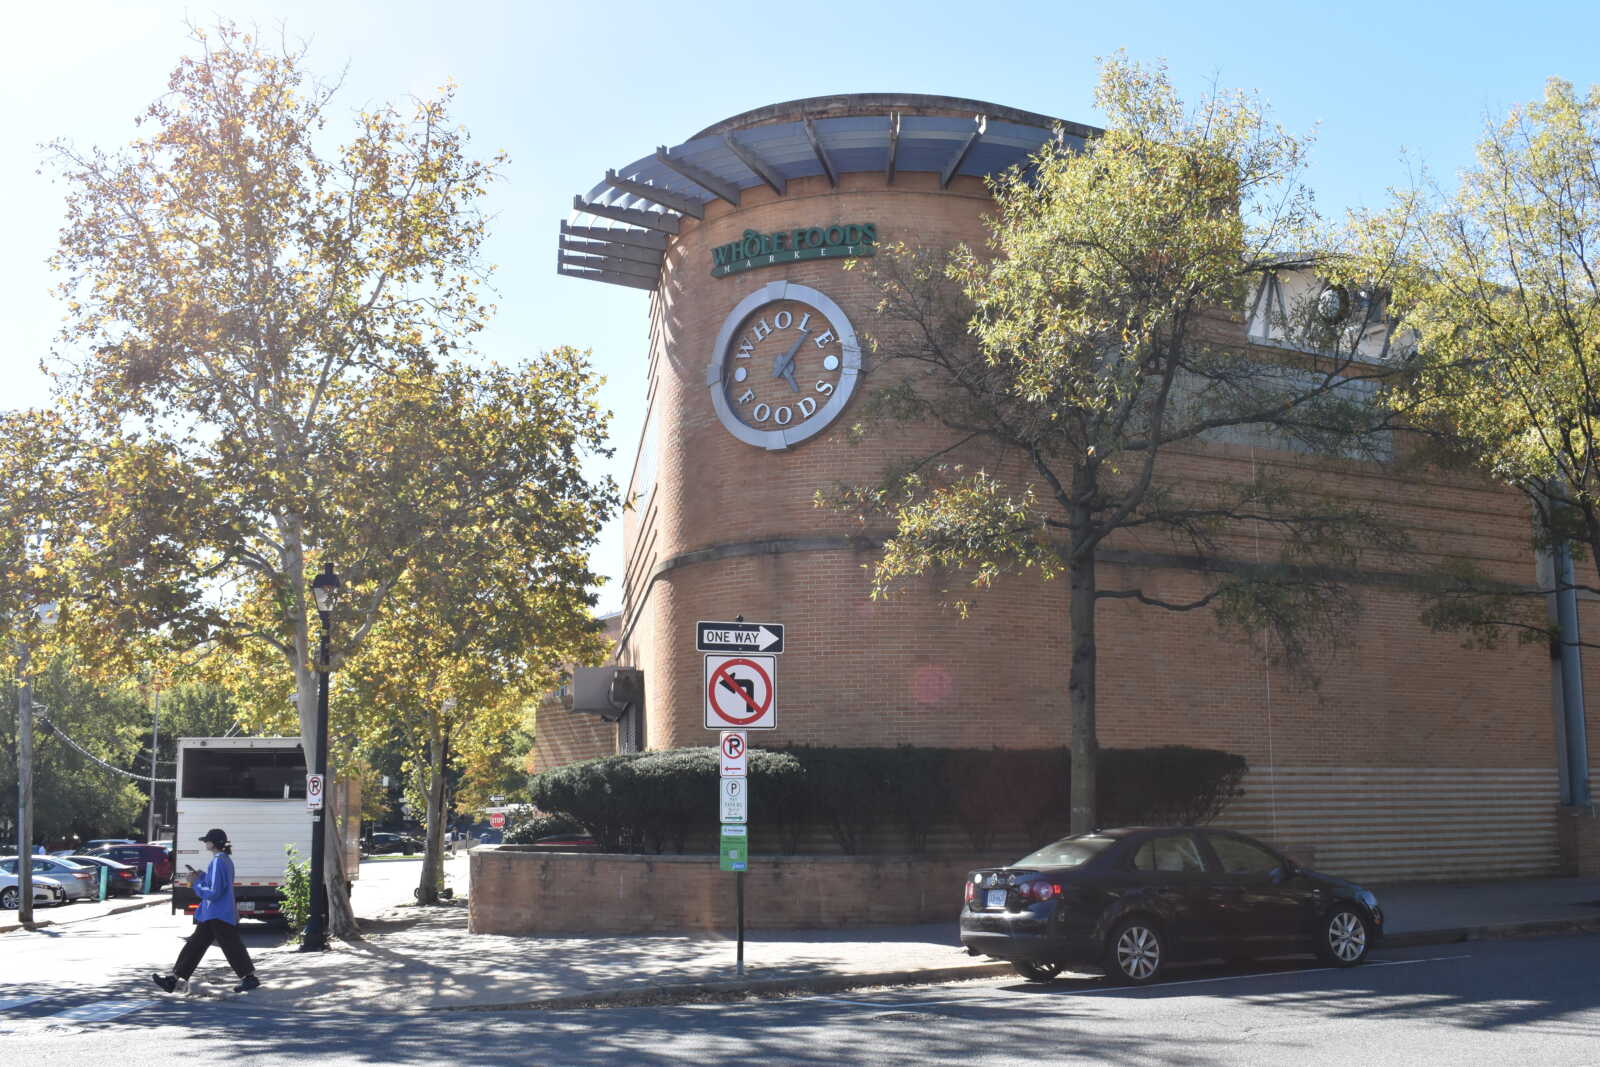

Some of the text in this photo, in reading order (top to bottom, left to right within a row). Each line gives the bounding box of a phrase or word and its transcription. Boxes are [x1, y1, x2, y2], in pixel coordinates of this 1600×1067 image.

[712, 223, 877, 266] WHOLE FOODS
[724, 246, 855, 273] MARKET
[736, 311, 834, 360] WHOLE
[737, 380, 834, 425] FOODS
[706, 631, 760, 643] ONE WAY
[730, 782, 737, 794] P
